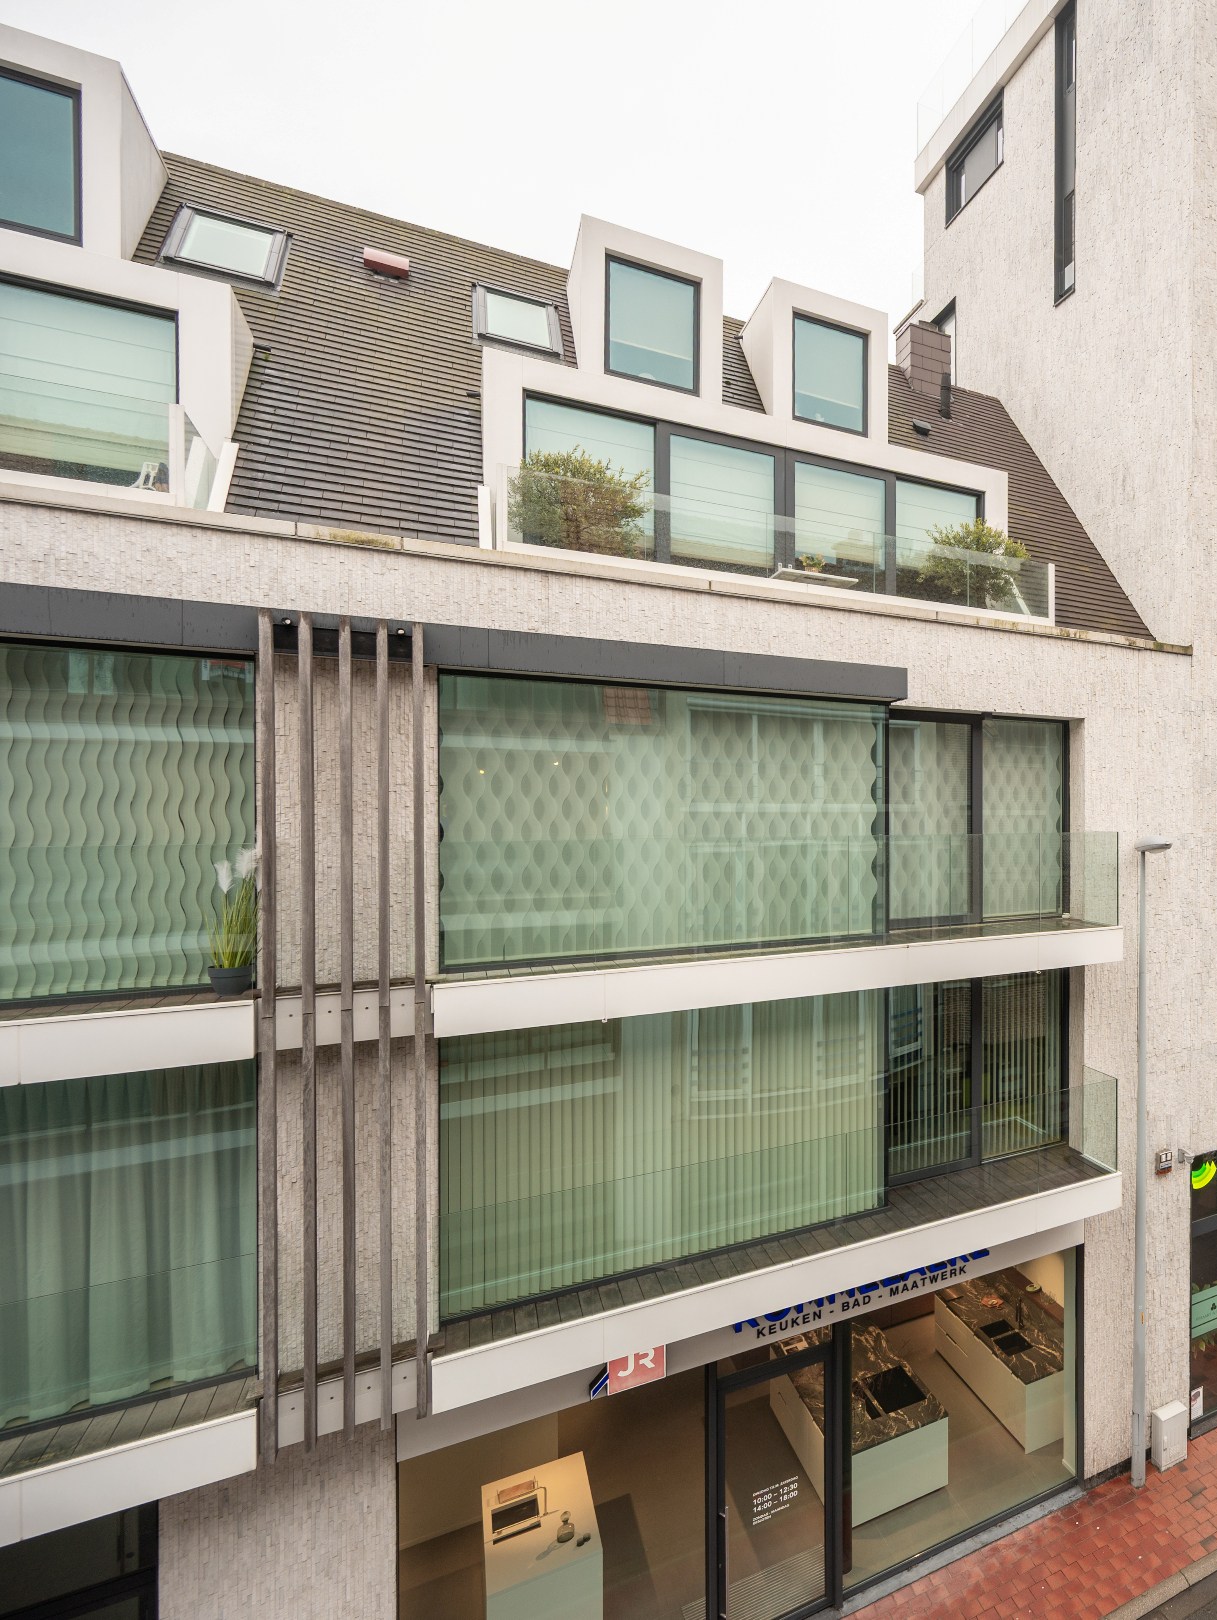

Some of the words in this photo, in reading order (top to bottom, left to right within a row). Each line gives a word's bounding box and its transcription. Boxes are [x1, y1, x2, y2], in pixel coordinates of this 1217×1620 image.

[756, 1310, 822, 1339] KEUKEN
[841, 1295, 872, 1313] BAD
[889, 1264, 967, 1298] MAATWERK
[753, 1493, 773, 1505] 10:00
[779, 1482, 798, 1495] 12:30
[753, 1501, 773, 1513] 14:00
[779, 1490, 798, 1502] 18:00
